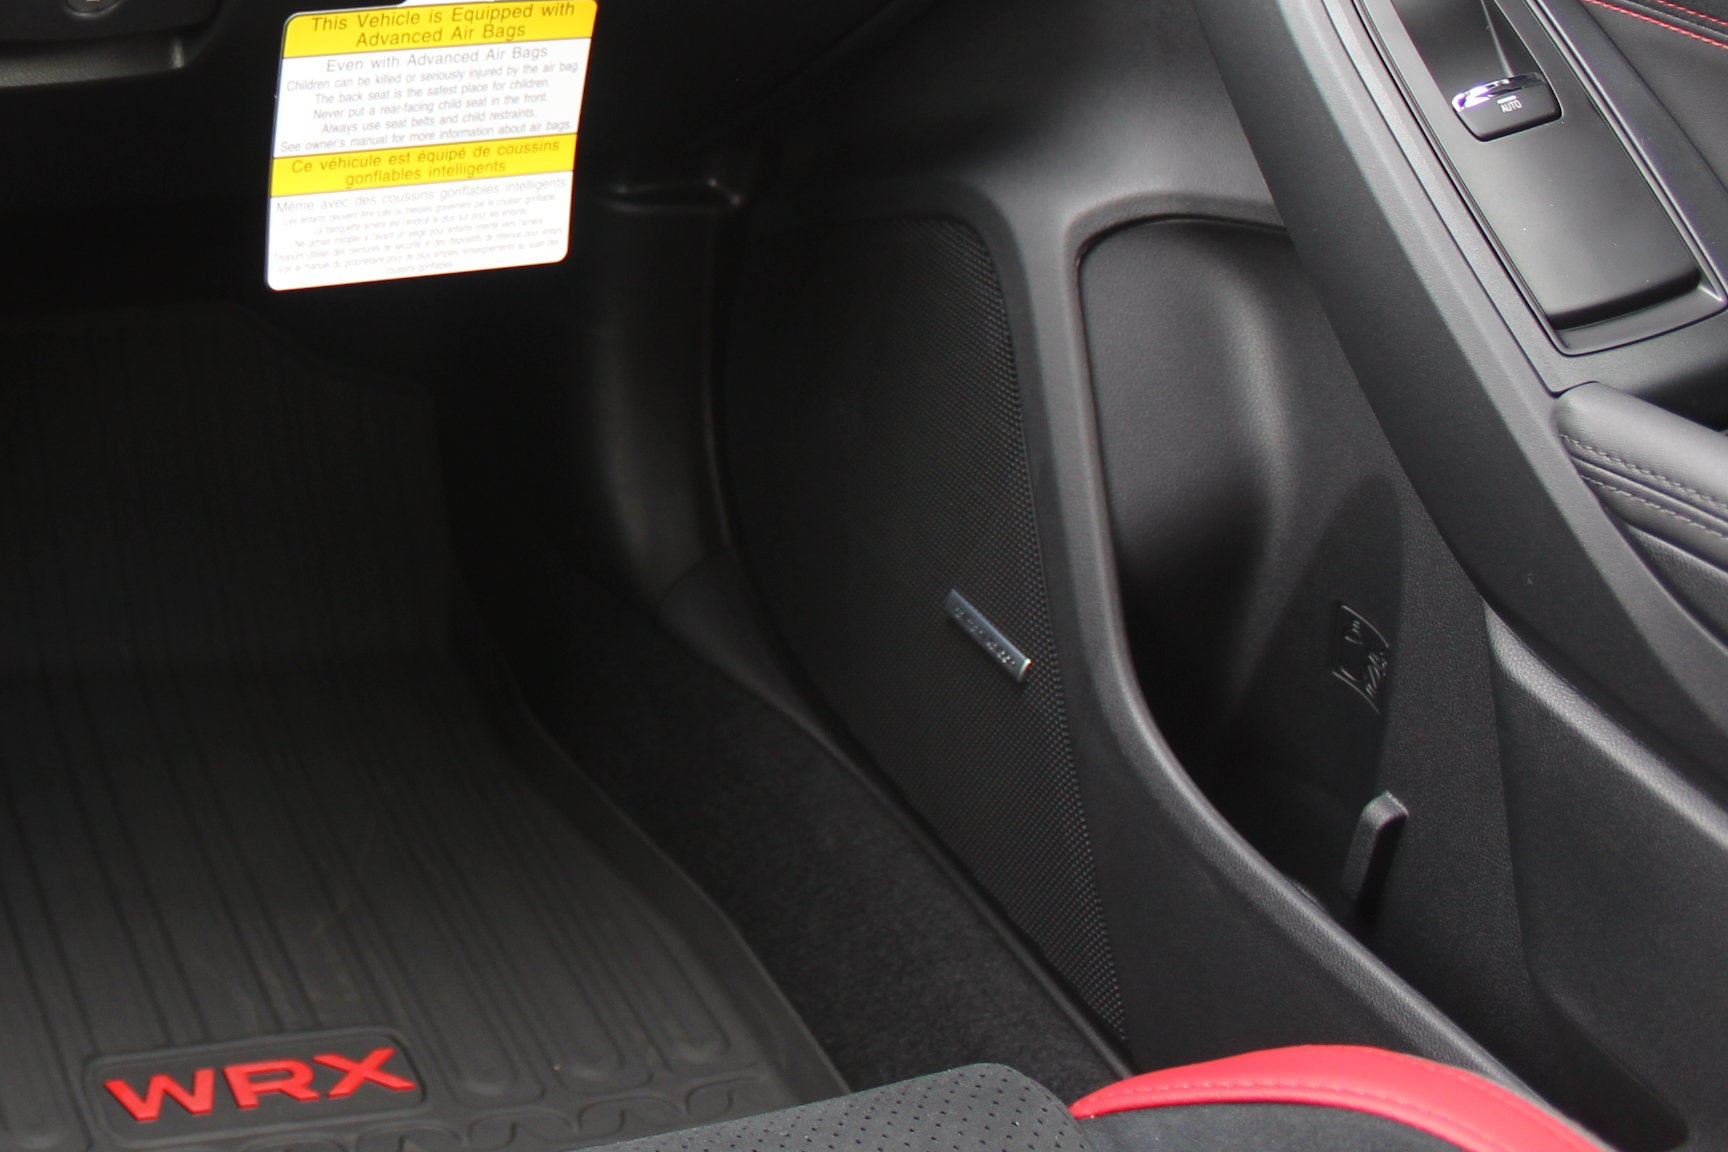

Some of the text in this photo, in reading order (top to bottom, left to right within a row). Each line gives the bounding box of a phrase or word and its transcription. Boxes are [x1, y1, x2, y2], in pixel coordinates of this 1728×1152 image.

[312, 1, 575, 31] This Vehicle is Equipped with
[356, 23, 525, 50] Advanced Air Bags
[326, 46, 547, 72] Even with Advanced Air Bags
[1501, 100, 1522, 113] AUTO
[291, 140, 560, 173] Ce véhicule est équipé de coussins
[345, 161, 507, 190] gonflables intelligents
[104, 1047, 416, 1122] WRX
